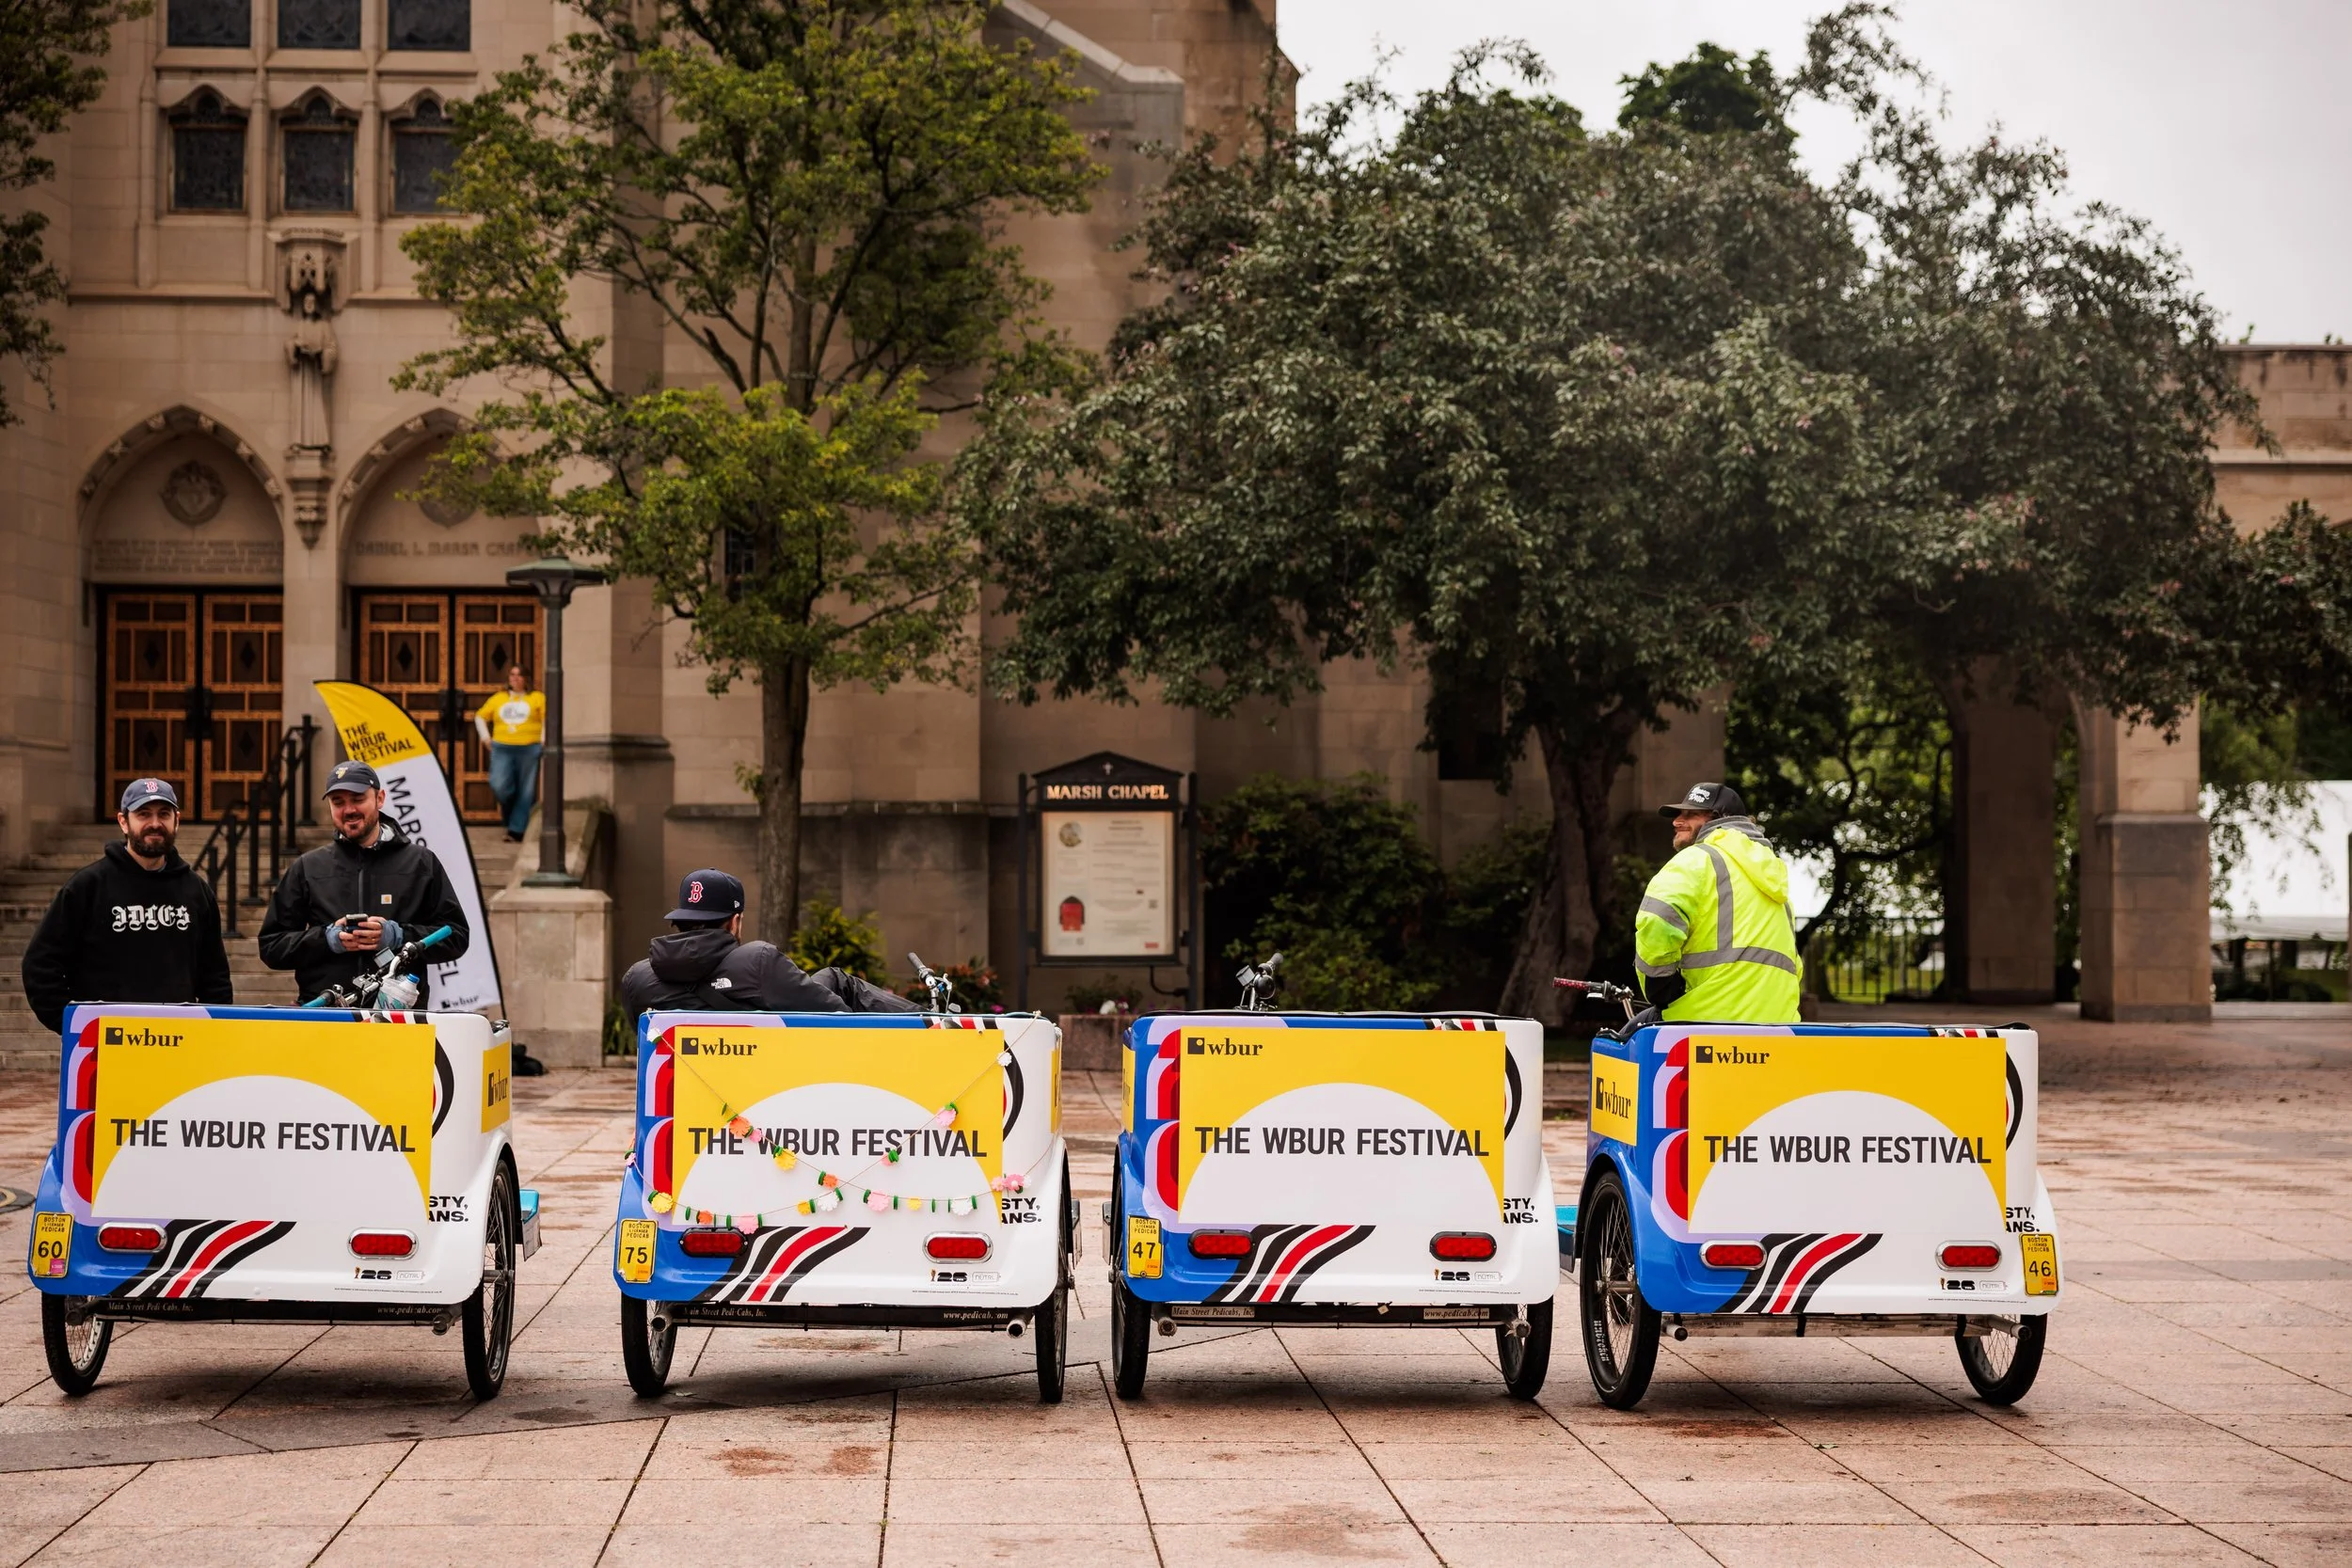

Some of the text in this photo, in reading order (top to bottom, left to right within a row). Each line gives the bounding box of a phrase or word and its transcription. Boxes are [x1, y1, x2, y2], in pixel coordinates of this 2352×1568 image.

[344, 721, 369, 739] THE
[348, 731, 387, 752] WBUR
[353, 737, 415, 762] FESTIVAL
[145, 781, 159, 793] B
[1047, 784, 1168, 800] MARSH CHAPEL
[688, 880, 704, 903] B
[125, 1028, 183, 1047] wbur
[702, 1038, 757, 1055] wbur
[1207, 1037, 1263, 1055] wbur
[1716, 1046, 1770, 1065] wbur
[1604, 1082, 1631, 1119] wbur
[110, 1118, 416, 1152] THE WBUR FESTIVAL
[689, 1128, 988, 1157] THE WBUR FESTIVAL
[1194, 1127, 1489, 1157] THE WBUR FESTIVAL
[1704, 1135, 1992, 1164] THE WBUR FESTIVAL
[39, 1241, 63, 1259] 60
[625, 1246, 648, 1264] 75
[1133, 1242, 1156, 1259] 47
[2028, 1260, 2051, 1276] 46
[126, 1302, 144, 1310] Sreet
[702, 1307, 719, 1316] Street
[756, 1308, 767, 1317] Inc.
[1191, 1307, 1210, 1316] Street
[1212, 1307, 1241, 1317] Pedicabs,
